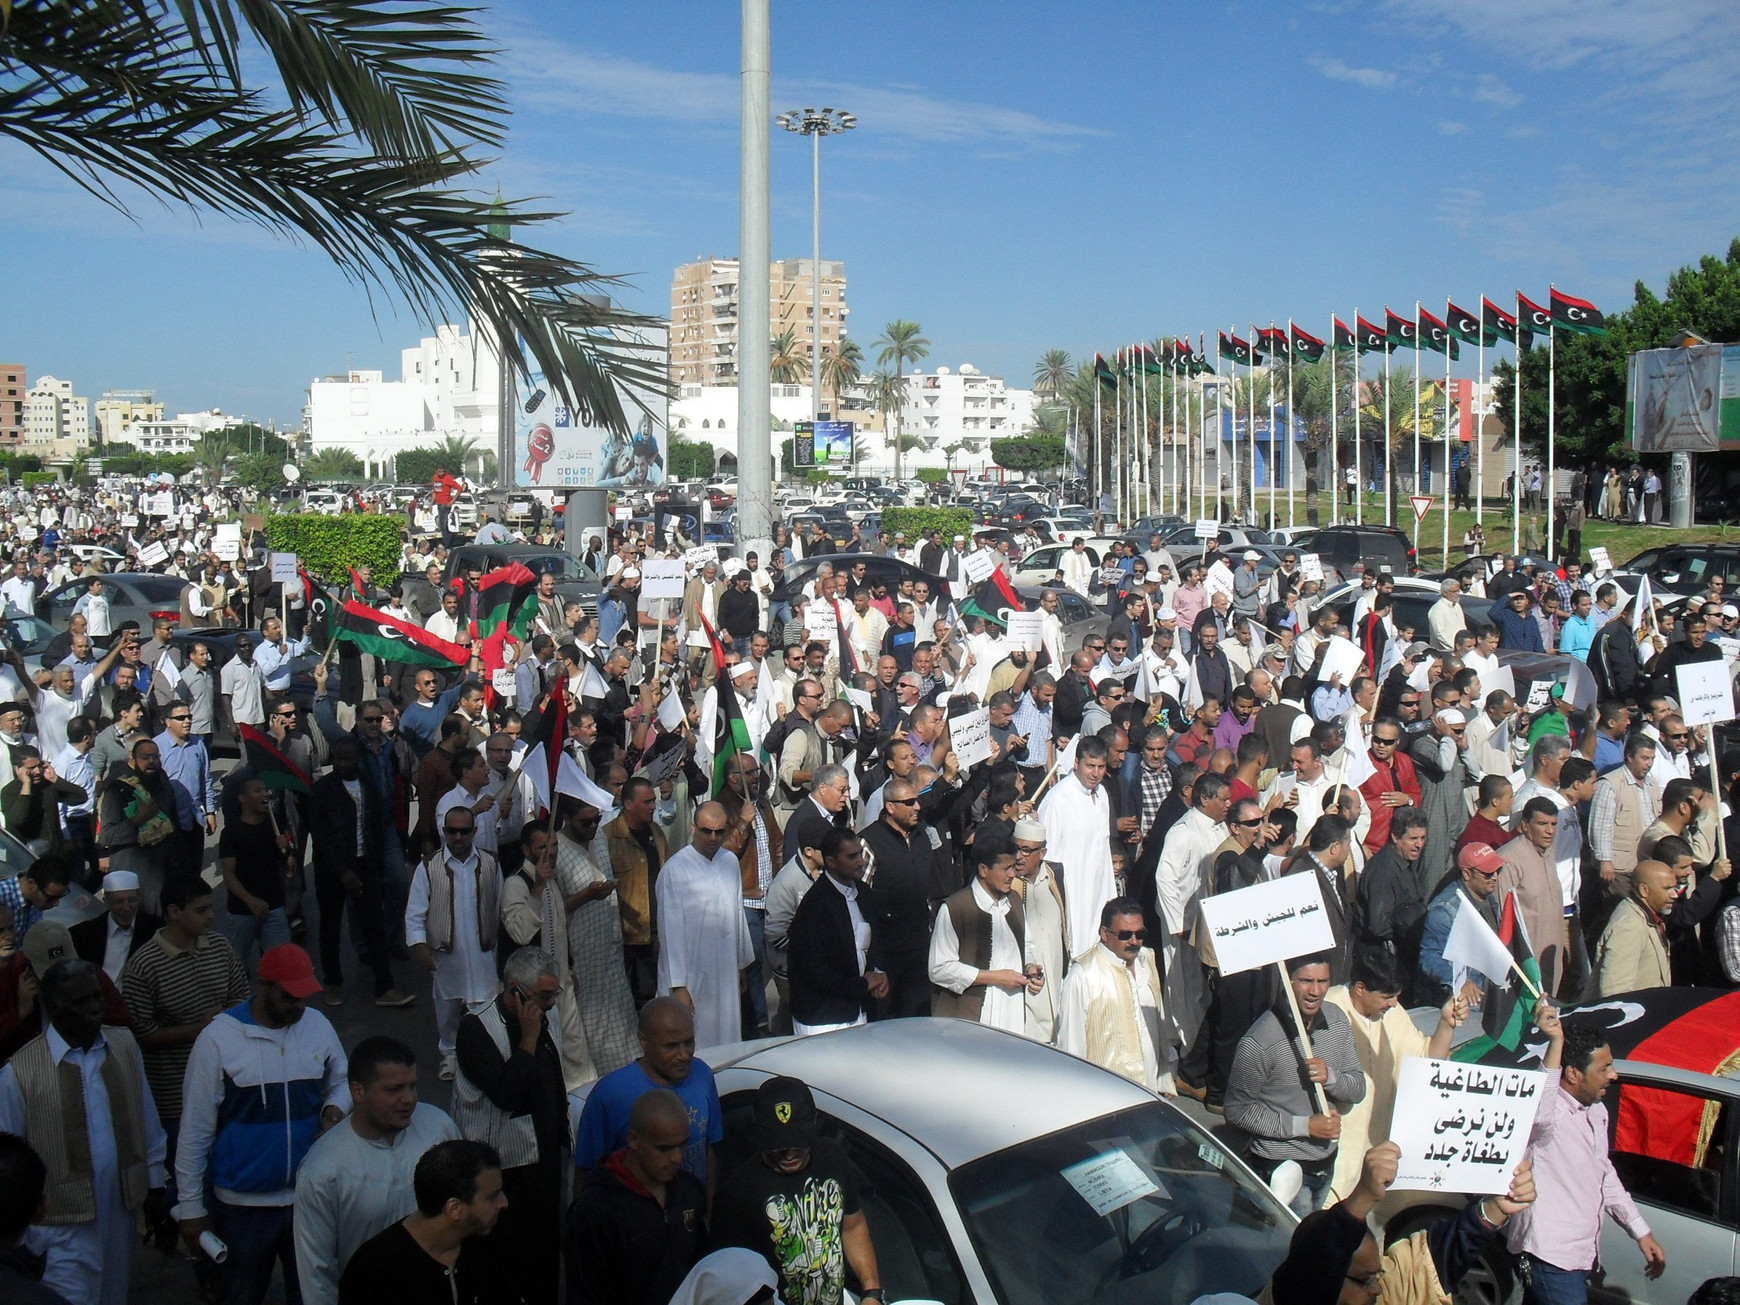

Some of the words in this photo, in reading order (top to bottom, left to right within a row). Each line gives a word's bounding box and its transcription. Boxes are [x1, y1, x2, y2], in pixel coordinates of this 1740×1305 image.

[1262, 907, 1296, 927] للجيش
[1299, 900, 1320, 918] نعم
[1215, 918, 1259, 937] والشرطة
[1429, 1062, 1503, 1099] الطاغية
[1505, 1073, 1536, 1098] مات
[1434, 1107, 1485, 1137] نرضى
[1485, 1111, 1516, 1140] ولن
[1424, 1142, 1459, 1168] جدد
[1461, 1141, 1510, 1174] بطغاة
